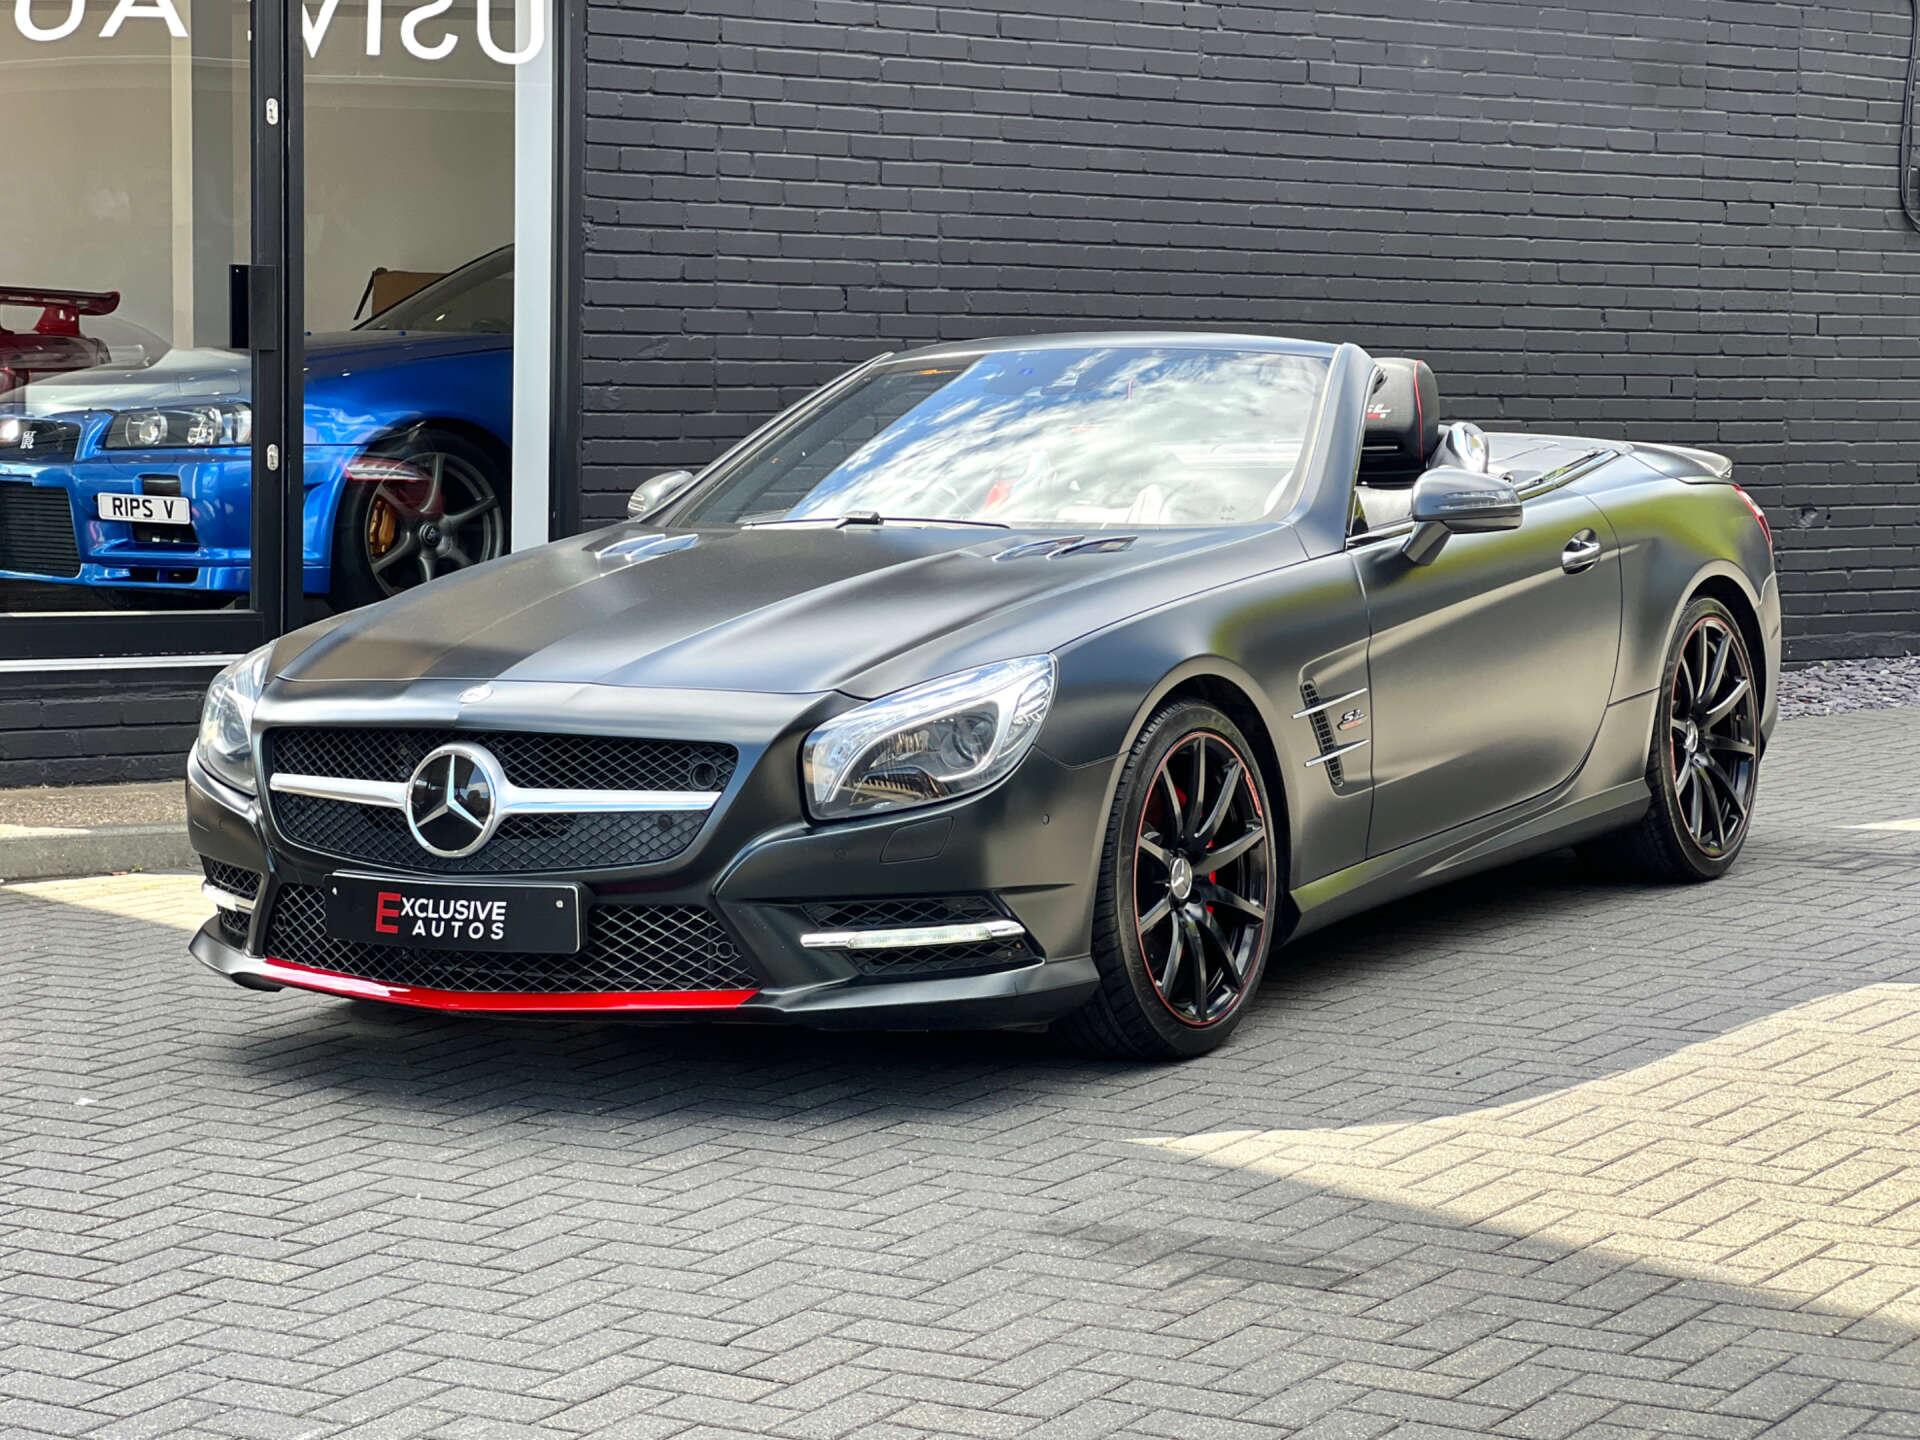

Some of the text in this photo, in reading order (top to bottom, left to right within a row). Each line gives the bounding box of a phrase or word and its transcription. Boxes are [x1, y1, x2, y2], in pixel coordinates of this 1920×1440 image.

[112, 497, 174, 519] RIPS V
[375, 891, 507, 934] EXCLUSIVE
[412, 919, 505, 940] AUTOS
